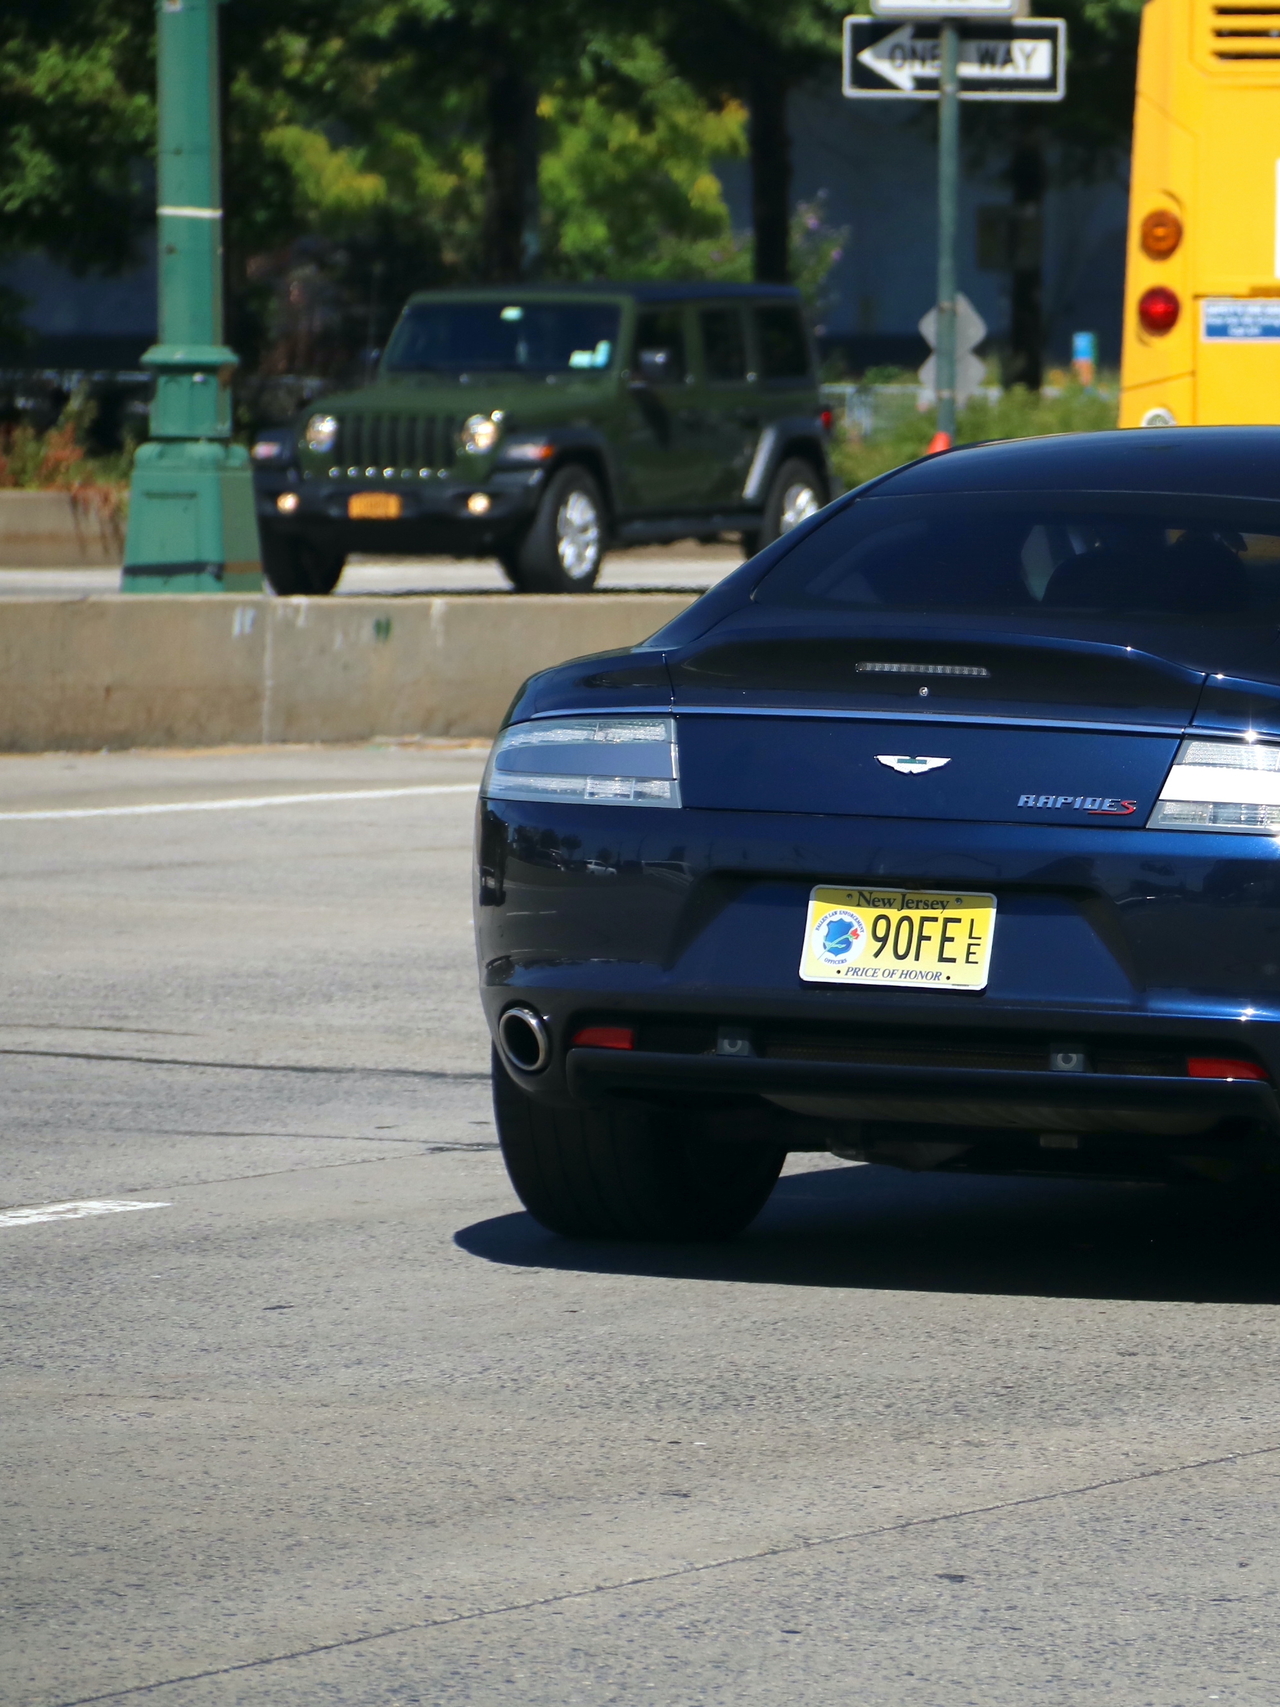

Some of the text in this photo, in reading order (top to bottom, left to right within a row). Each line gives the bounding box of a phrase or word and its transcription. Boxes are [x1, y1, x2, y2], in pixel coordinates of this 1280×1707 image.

[976, 43, 1037, 72] WAY
[856, 892, 949, 914] New Jersey
[815, 910, 865, 933] FALLEN LAW ENFORCEMENT
[824, 957, 847, 965] OFFICERS
[844, 966, 942, 981] PRICE OF HONOR
